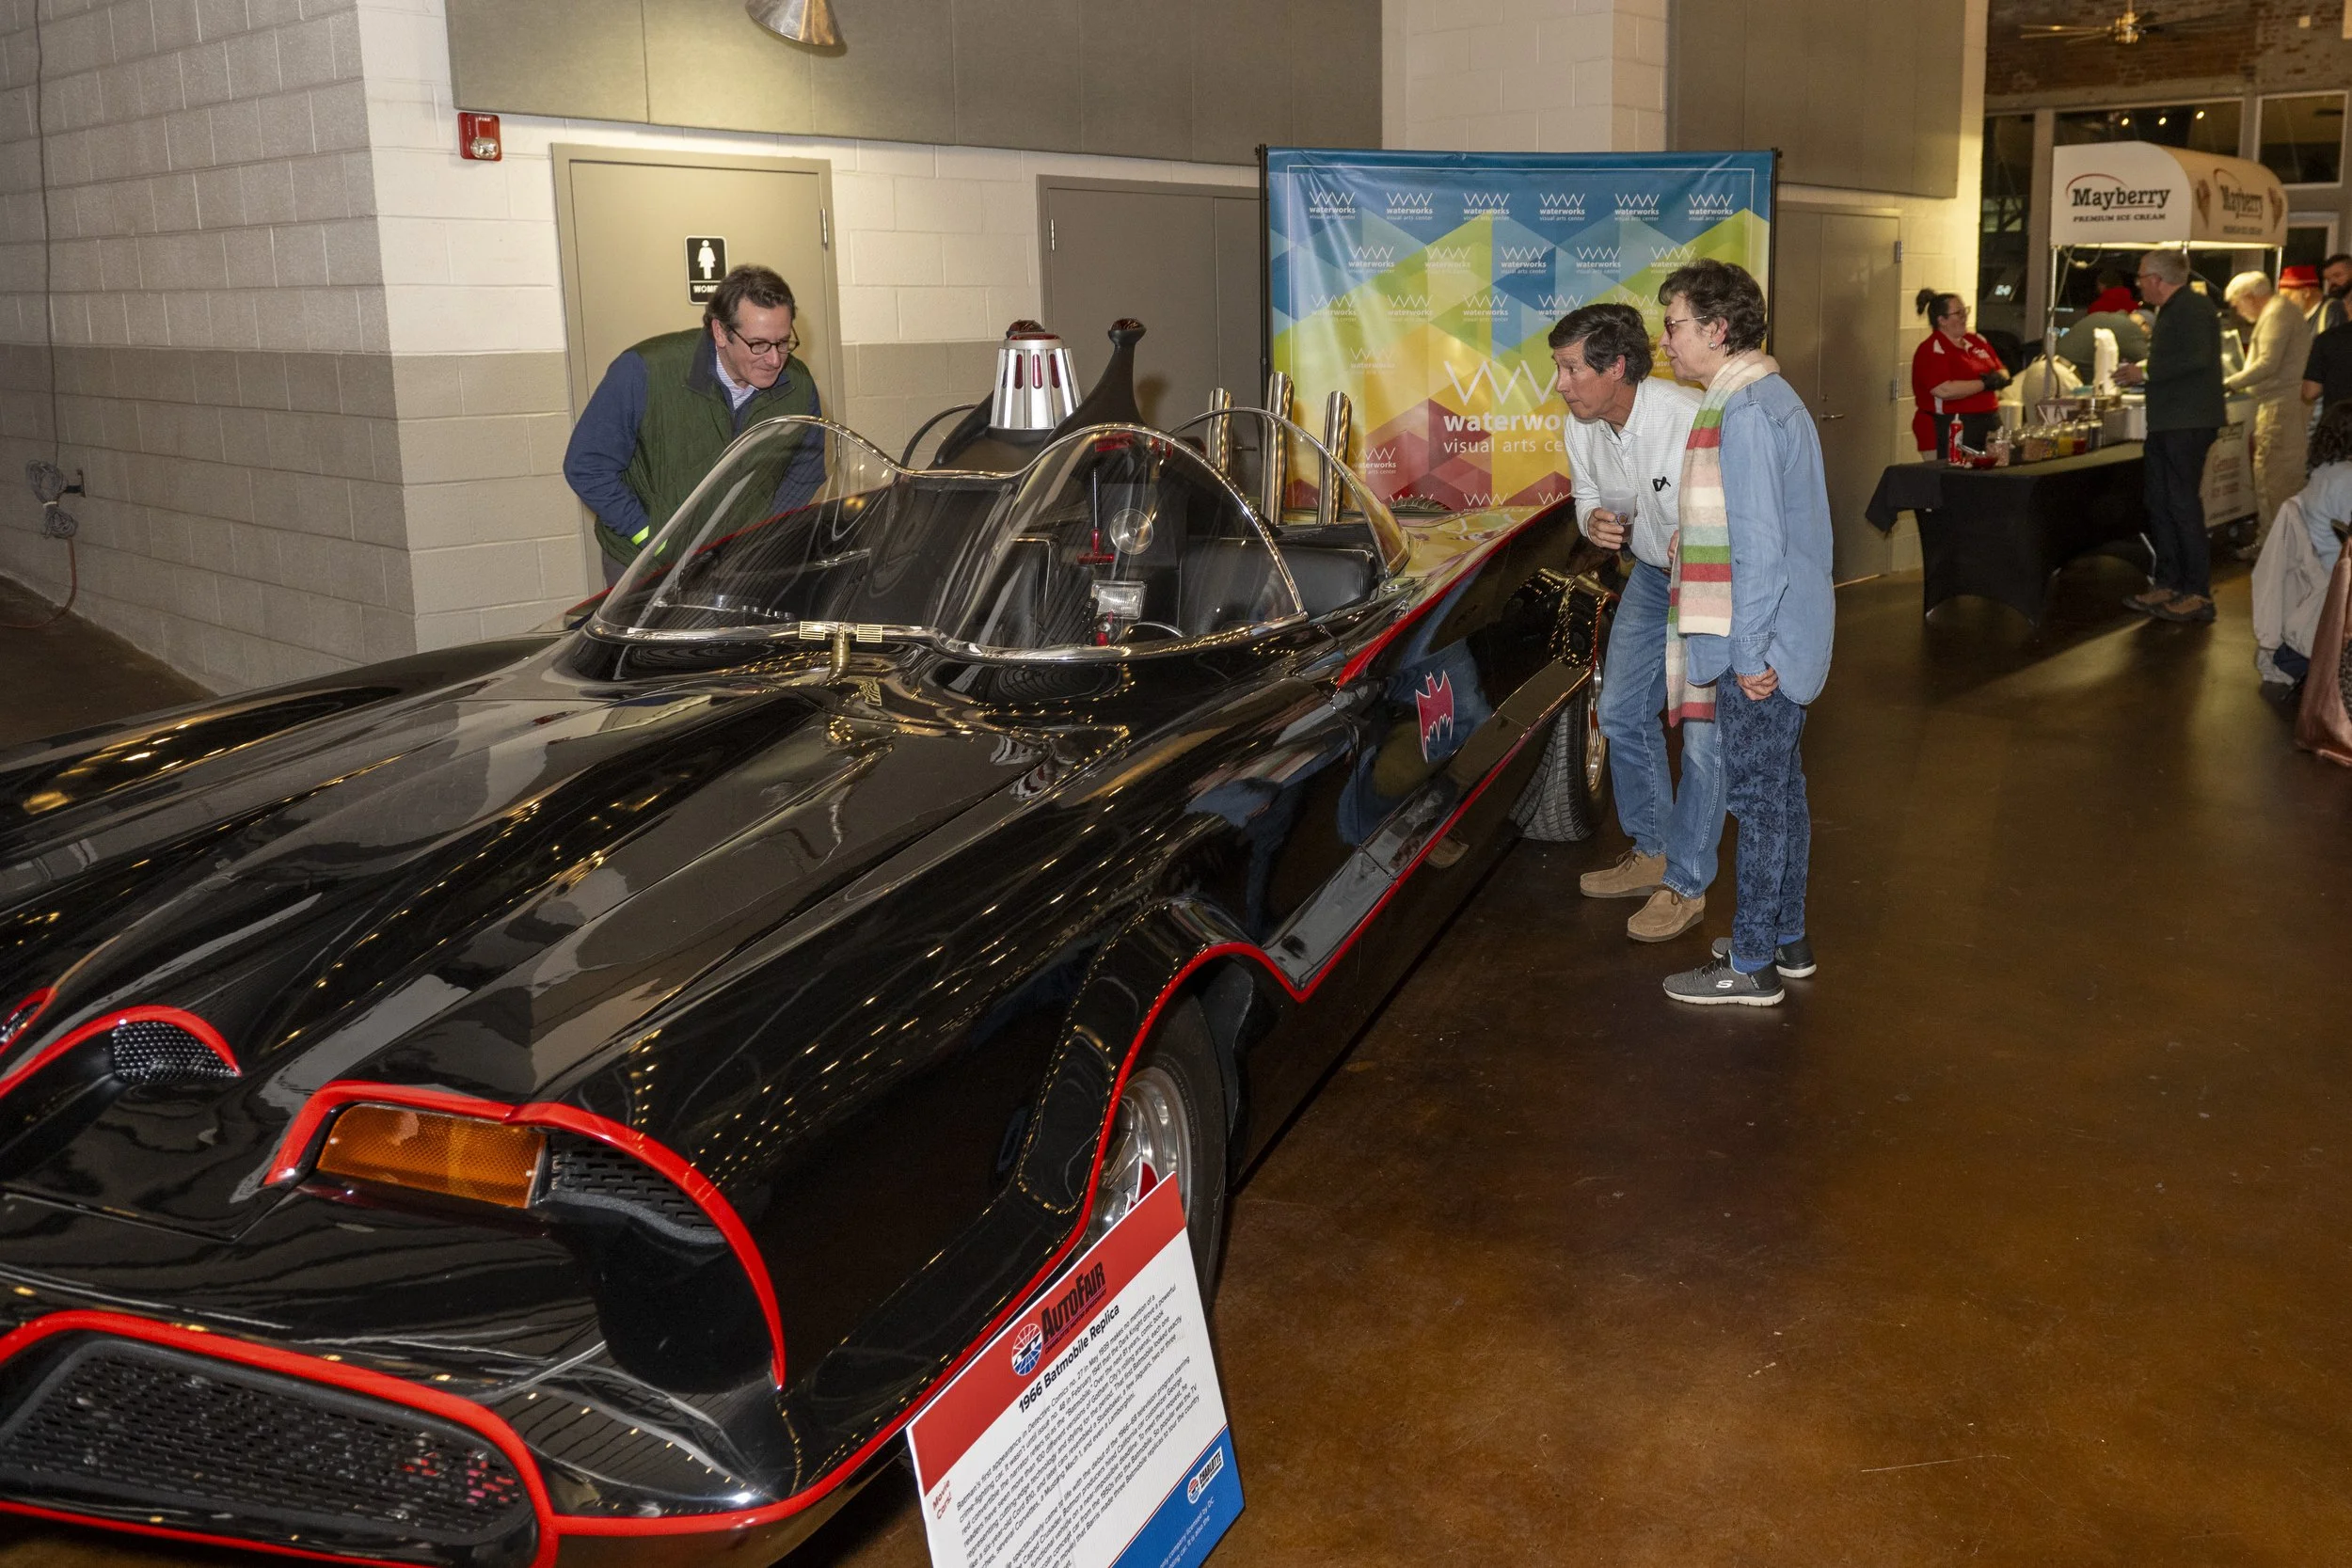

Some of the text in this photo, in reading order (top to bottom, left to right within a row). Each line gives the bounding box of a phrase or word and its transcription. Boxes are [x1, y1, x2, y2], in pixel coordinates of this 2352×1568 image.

[2072, 187, 2171, 210] Mayberry
[2073, 214, 2114, 222] PREMIUM
[1443, 438, 1494, 453] visual
[1502, 440, 1536, 452] arts
[981, 1468, 991, 1484] first
[992, 1437, 1021, 1473] appearance
[1022, 1431, 1027, 1440] in
[1028, 1406, 1050, 1434] Detective
[1051, 1387, 1068, 1409] Comics
[1077, 1369, 1083, 1381] 27
[1083, 1365, 1088, 1374] in
[1089, 1355, 1098, 1368] May
[1099, 1341, 1109, 1357] 1939
[1110, 1328, 1123, 1346] makes
[1124, 1321, 1130, 1331] no
[1130, 1303, 1146, 1324] mention
[1147, 1296, 1151, 1306] of
[1018, 1304, 1119, 1413] 1966 Batmobile Replica
[959, 1480, 995, 1523] crime-fighting
[1004, 1463, 1009, 1473] It
[1026, 1432, 1037, 1450] until
[1037, 1420, 1050, 1437] issue
[1059, 1402, 1065, 1414] 48
[1066, 1397, 1071, 1406] in
[1071, 1375, 1092, 1400] February
[1092, 1362, 1102, 1378] 1941
[1102, 1353, 1111, 1367] that
[1118, 1333, 1129, 1349] Dark
[1129, 1318, 1143, 1338] Knight
[1142, 1307, 1154, 1323] drove
[1158, 1282, 1176, 1308] powerful
[961, 1519, 970, 1535] red
[971, 1489, 1000, 1524] convertible
[1000, 1479, 1009, 1492] the
[1010, 1456, 1029, 1482] narrator
[1030, 1440, 1044, 1459] refers
[1045, 1433, 1050, 1443] to
[1050, 1426, 1056, 1437] as
[1093, 1374, 1104, 1389] Over
[1113, 1353, 1122, 1368] next
[1122, 1346, 1128, 1358] 81
[1141, 1321, 1153, 1337] comic
[1153, 1307, 1163, 1324] book
[964, 1521, 983, 1547] readers
[984, 1506, 997, 1524] have
[998, 1491, 1010, 1509] seen
[1011, 1476, 1024, 1495] more
[1024, 1463, 1035, 1479] than
[1036, 1451, 1045, 1466] 100
[1045, 1429, 1066, 1456] different
[1066, 1408, 1085, 1433] versions
[1086, 1400, 1091, 1411] of
[1091, 1382, 1109, 1405] Gotham
[1121, 1353, 1135, 1372] rolling
[1151, 1323, 1161, 1339] each
[966, 1519, 999, 1559] representing
[999, 1484, 1030, 1522] cutting-edge
[1031, 1453, 1057, 1486] technology
[1058, 1440, 1067, 1456] and
[1068, 1424, 1083, 1445] styling
[1115, 1377, 1124, 1392] That
[1124, 1367, 1133, 1381] first
[1132, 1346, 1153, 1372] Batmobile
[1153, 1328, 1167, 1349] looked
[1167, 1314, 1182, 1333] exactly
[983, 1517, 1012, 1555] six-year-old
[1012, 1502, 1025, 1522] Cord
[1036, 1478, 1046, 1495] and
[1046, 1467, 1057, 1483] later
[1058, 1455, 1068, 1470] cars
[1069, 1425, 1092, 1458] resembled
[1126, 1380, 1134, 1393] few
[1152, 1351, 1160, 1364] two
[1160, 1345, 1165, 1355] or
[1165, 1333, 1176, 1349] three
[932, 1480, 950, 1511] Movie
[1199, 1450, 1220, 1485] CHARLOTTE
[937, 1492, 952, 1520] Cars!
[1168, 1533, 1186, 1559] company
[1186, 1510, 1202, 1536] licensed
[1201, 1505, 1207, 1515] by
[1207, 1495, 1214, 1508] DC
[1195, 1523, 1203, 1537] also
